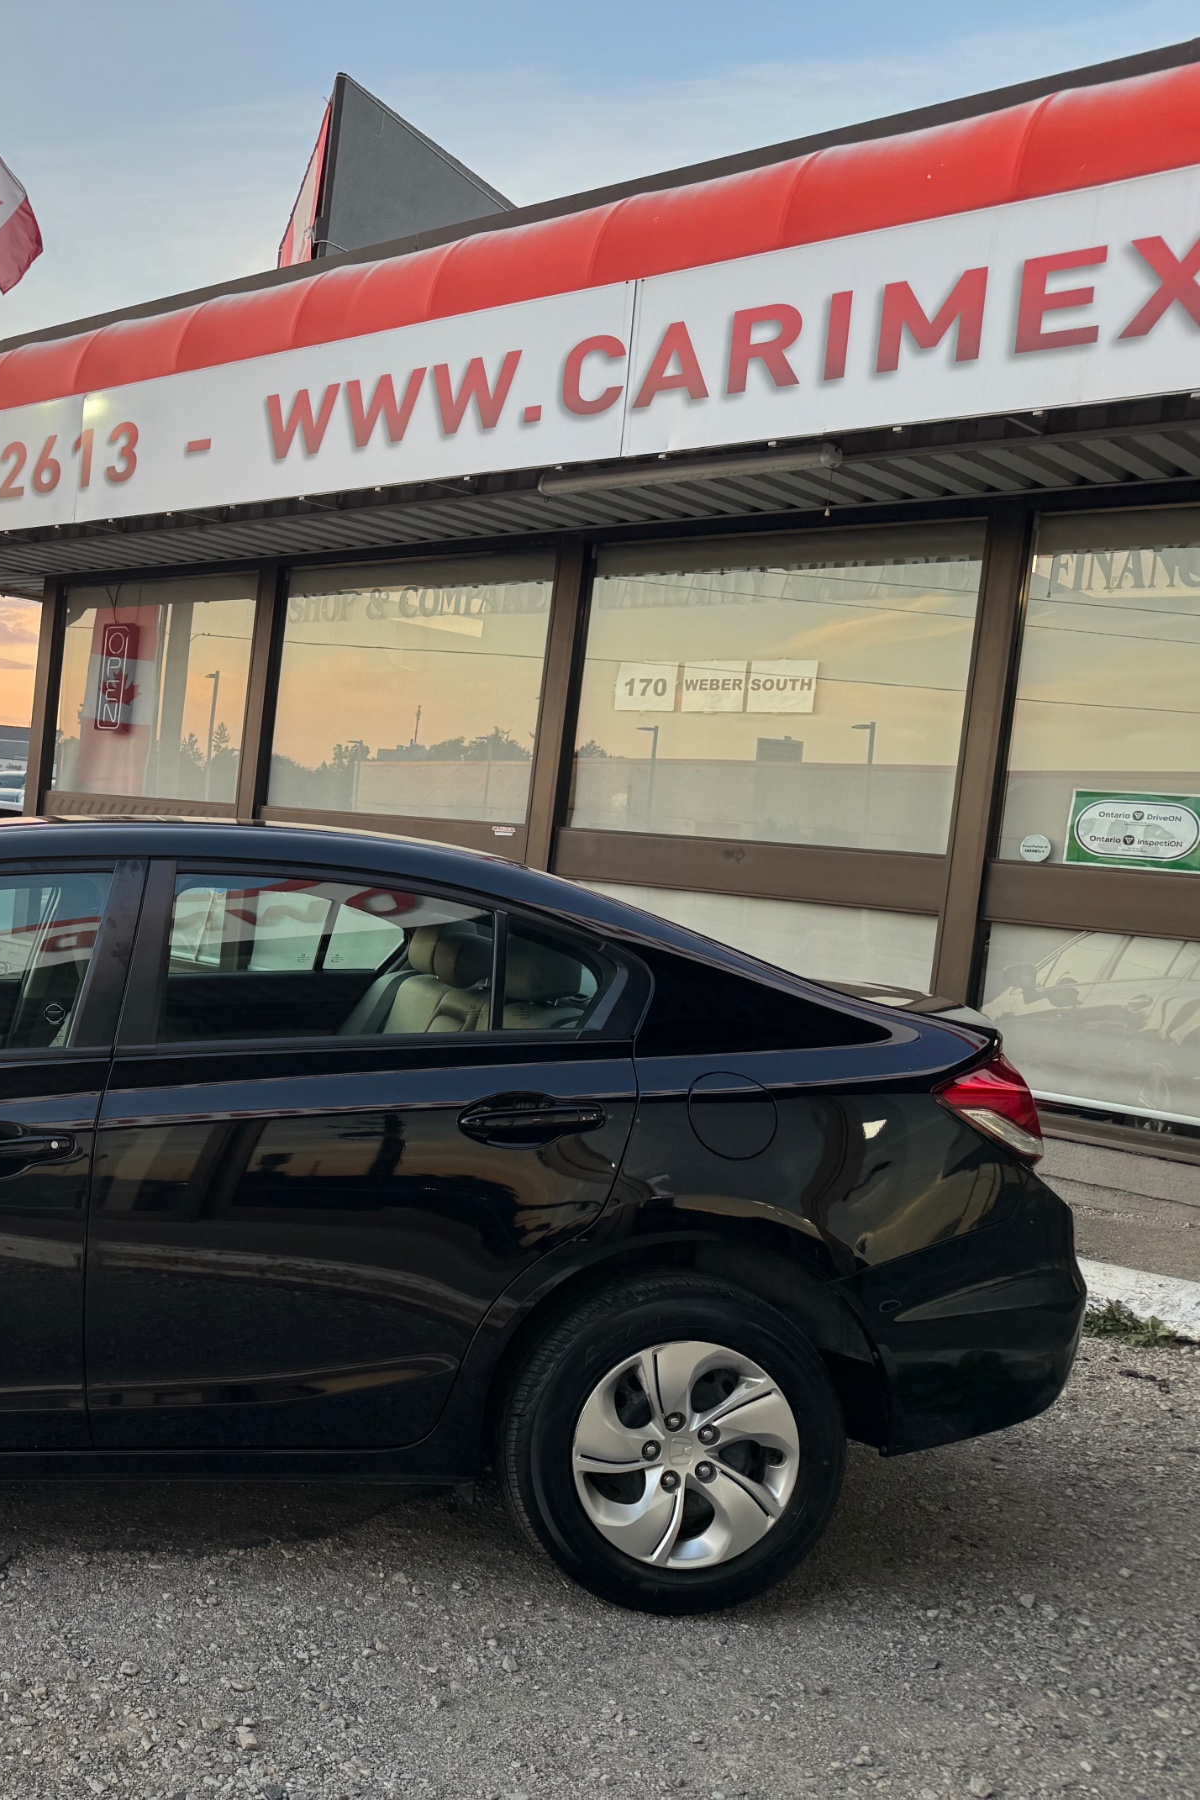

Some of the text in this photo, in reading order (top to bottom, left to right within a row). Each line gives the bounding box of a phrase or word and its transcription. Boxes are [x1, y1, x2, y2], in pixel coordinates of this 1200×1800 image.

[267, 226, 1200, 460] WWW.CARIMEX
[288, 590, 360, 624] SHOP
[365, 588, 390, 620] &
[102, 631, 126, 724] OPEN
[624, 678, 813, 697] 170 WEBER SOUTH
[1098, 811, 1182, 822] Ontario DriveON
[1089, 835, 1121, 844] Ontario
